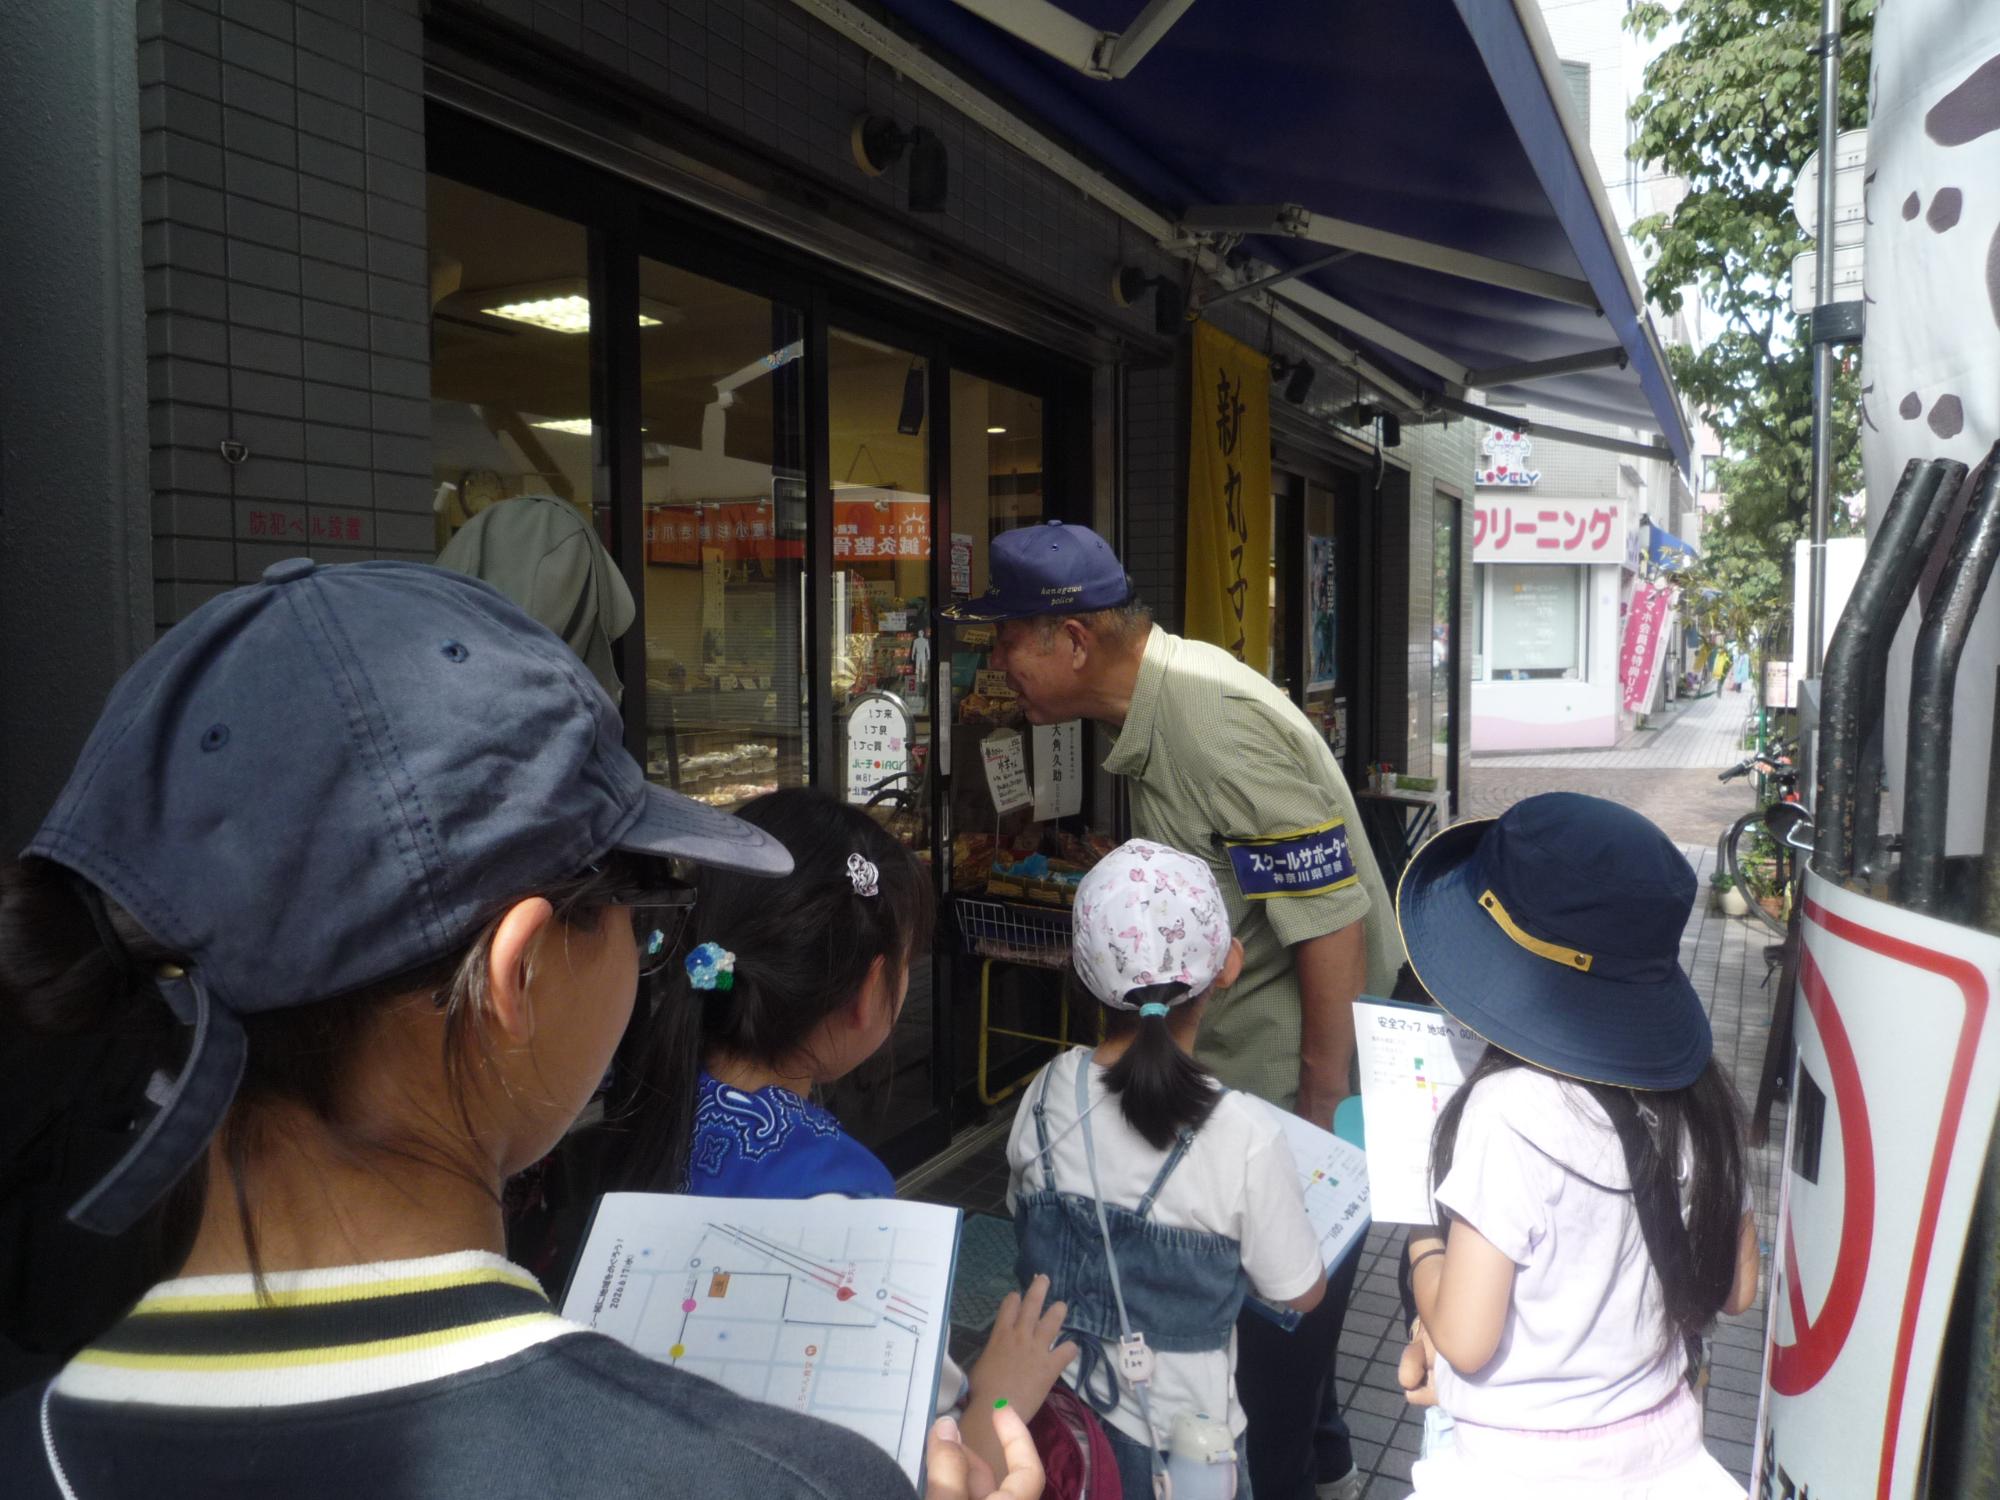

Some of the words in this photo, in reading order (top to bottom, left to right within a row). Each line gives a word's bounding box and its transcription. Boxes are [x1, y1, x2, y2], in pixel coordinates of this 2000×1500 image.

[1475, 470, 1540, 485] LOVELY
[249, 511, 361, 540] 防犯ベル設置
[1473, 505, 1618, 551] クリーニング
[1272, 860, 1344, 884] 神奈川県警察
[1377, 1015, 1423, 1033] 安全マップ
